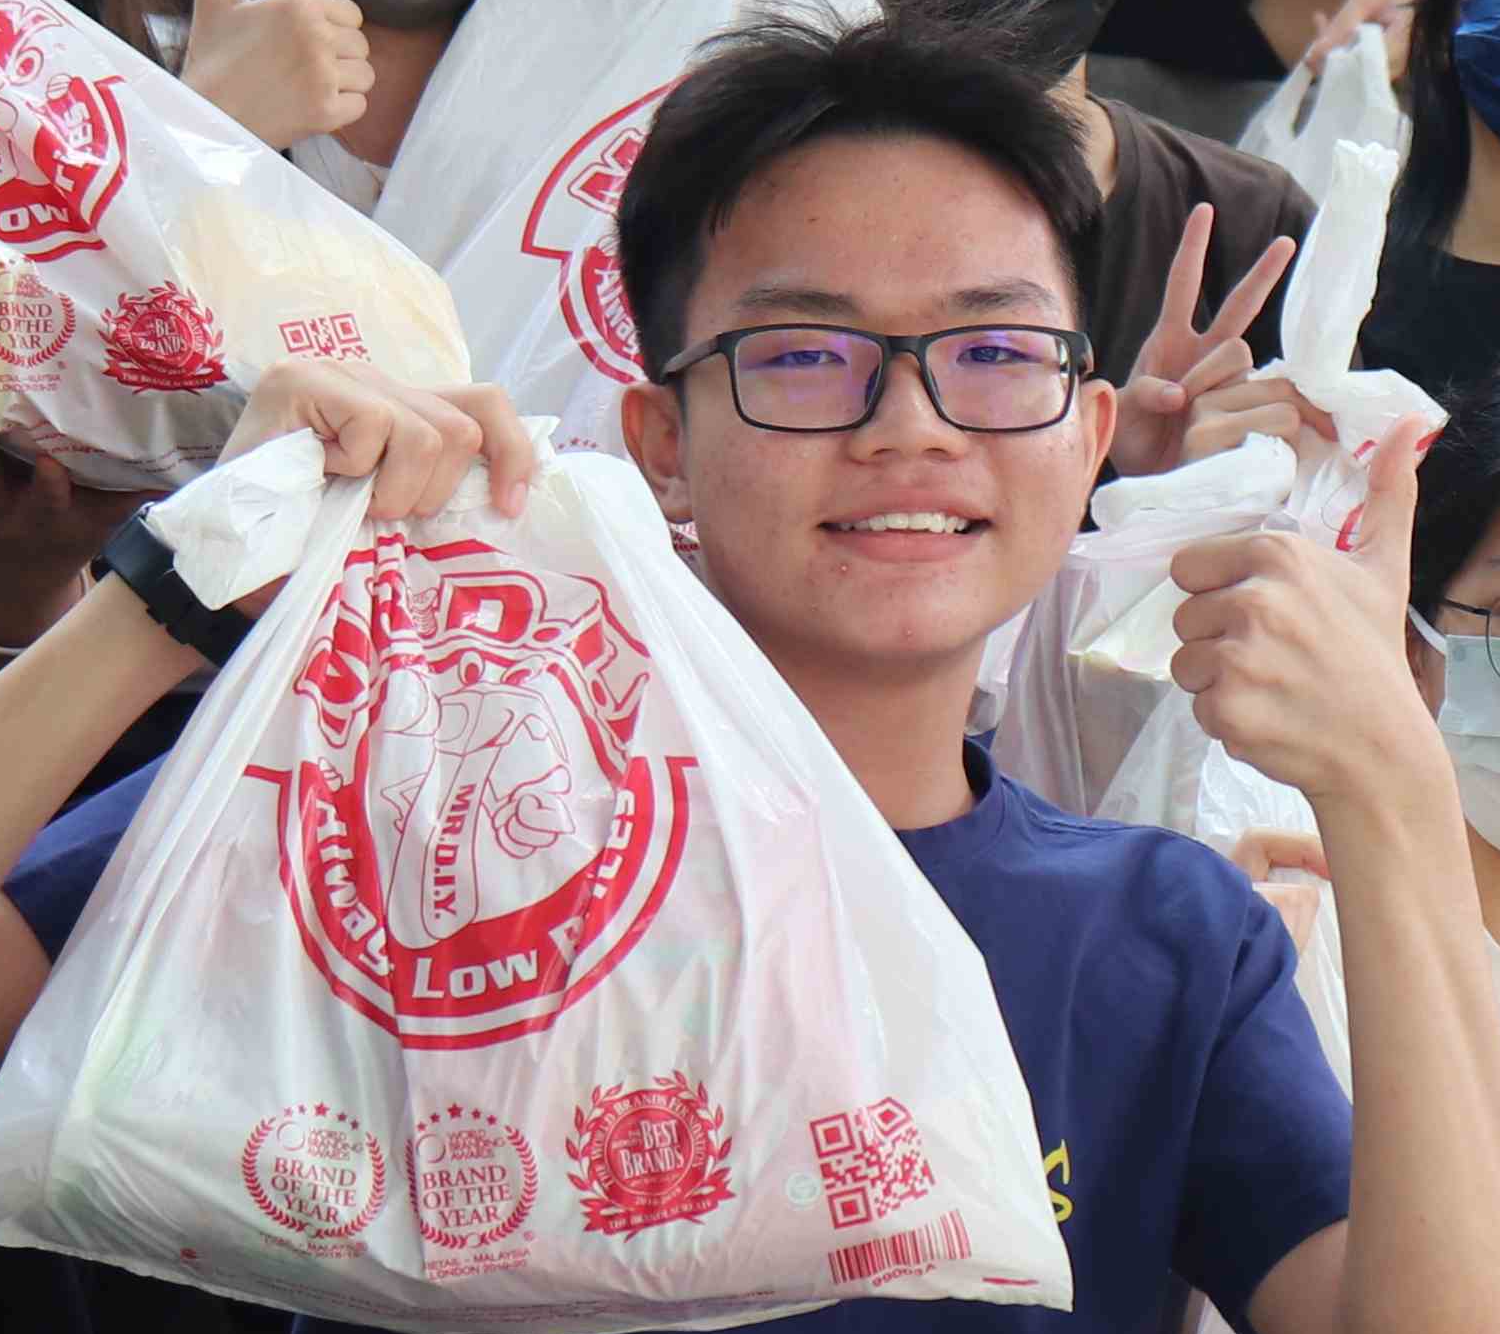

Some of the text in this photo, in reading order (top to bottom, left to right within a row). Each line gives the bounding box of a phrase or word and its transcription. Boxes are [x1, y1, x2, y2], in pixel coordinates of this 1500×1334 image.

[594, 267, 643, 356] Alway
[433, 783, 476, 921] MR.D.I.Y.
[315, 797, 395, 978] Alway
[412, 948, 538, 999] Low
[640, 1118, 679, 1150] BEST
[274, 1155, 357, 1187] BRAND
[422, 1165, 507, 1190] BRAND
[619, 1144, 686, 1181] BRANDS
[270, 1174, 357, 1208] OF THE
[423, 1183, 513, 1211] OF THE
[283, 1193, 342, 1225] YEAR
[438, 1204, 502, 1230] YEAR
